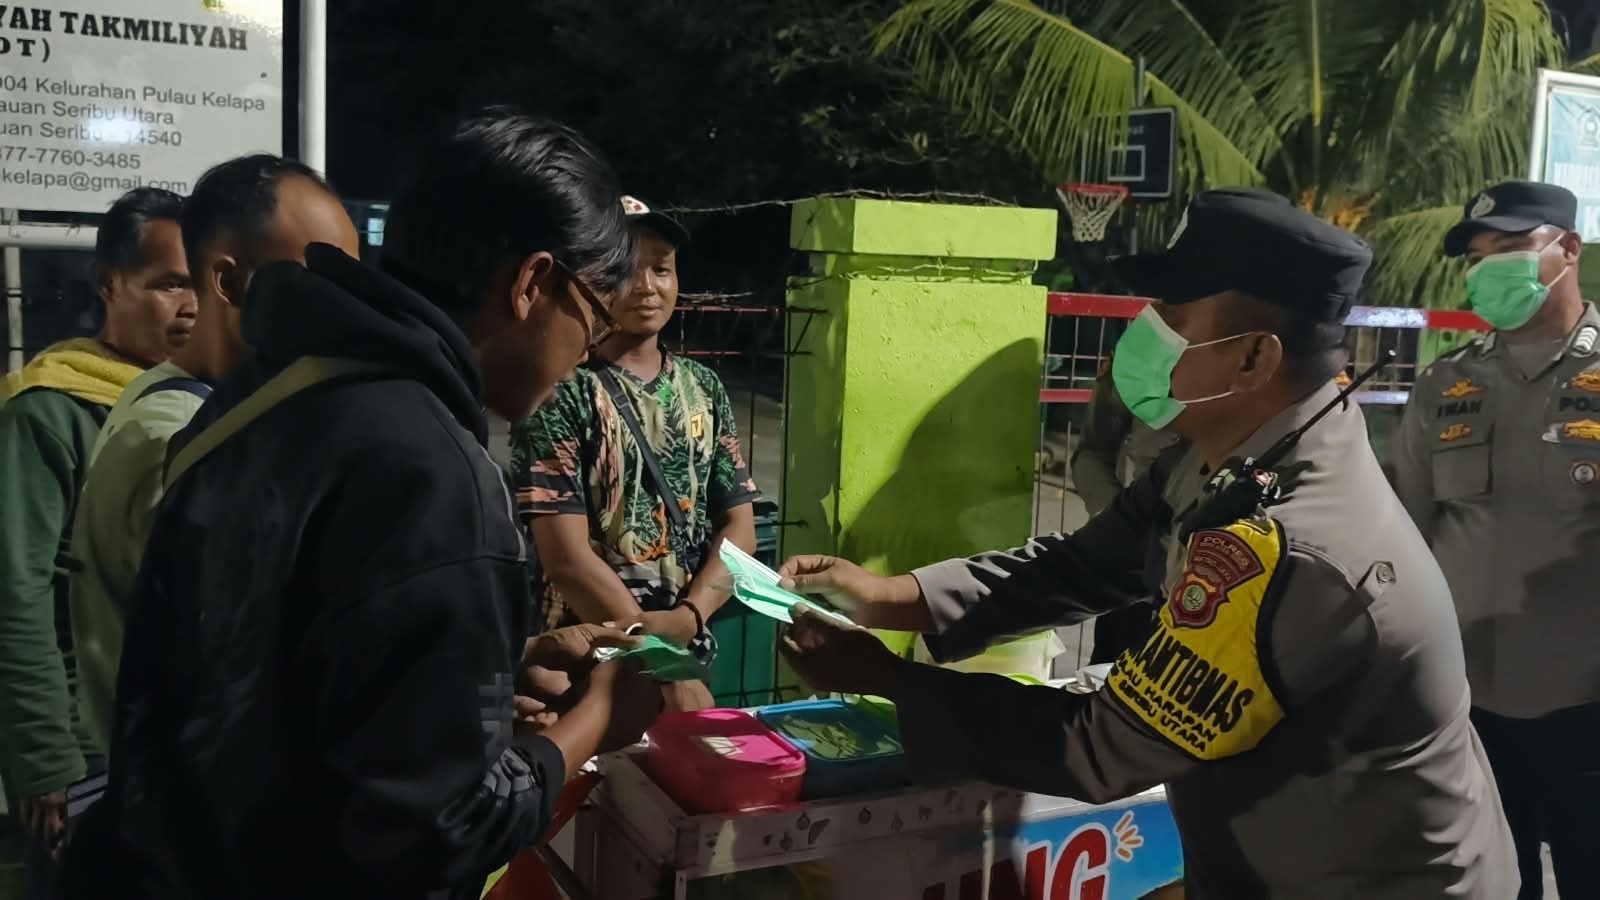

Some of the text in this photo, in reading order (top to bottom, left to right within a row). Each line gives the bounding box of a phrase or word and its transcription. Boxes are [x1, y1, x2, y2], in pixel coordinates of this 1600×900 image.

[59, 11, 248, 50] TAKMILIYAH
[0, 75, 265, 112] 04 Kelurahan Pulau Kelapa
[53, 100, 116, 121] Seribu
[122, 105, 174, 125] Utara
[0, 145, 141, 170] 77-7760-3485
[1144, 686, 1217, 742] HARAPAN
[1161, 715, 1206, 753] UTARA
